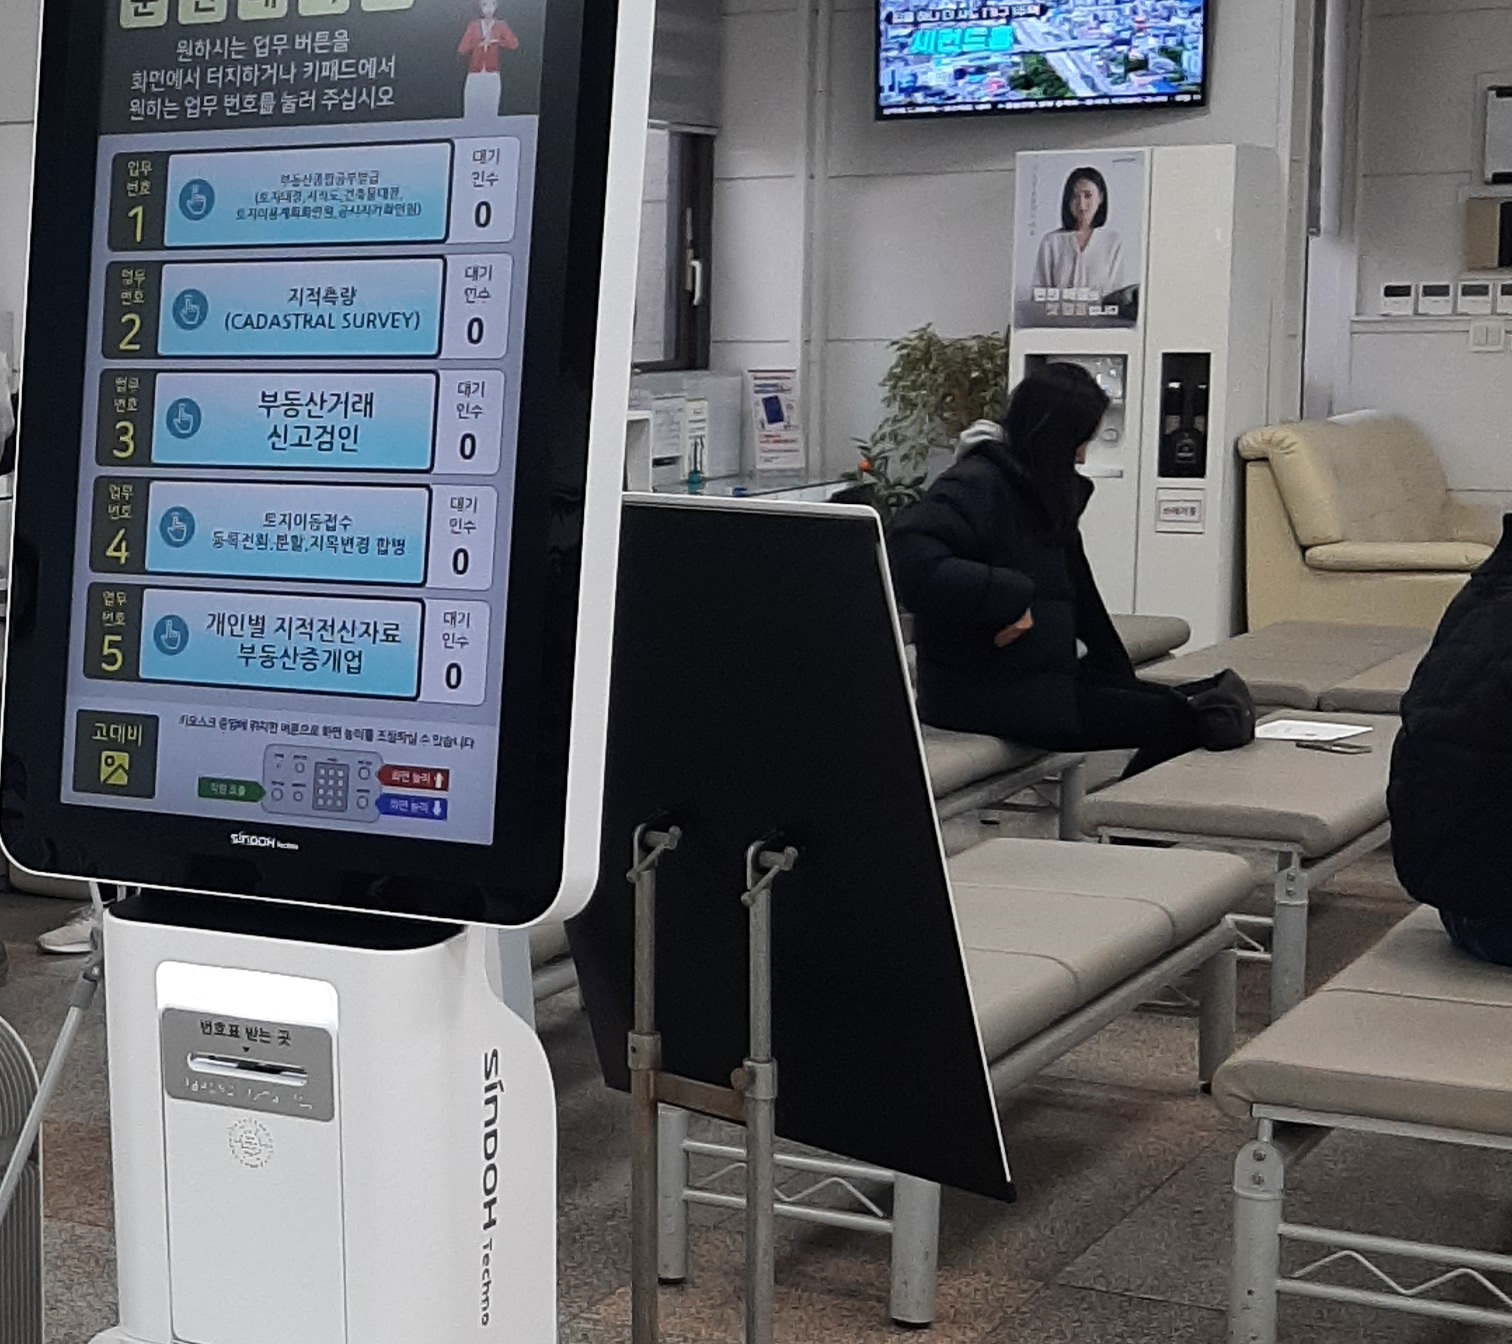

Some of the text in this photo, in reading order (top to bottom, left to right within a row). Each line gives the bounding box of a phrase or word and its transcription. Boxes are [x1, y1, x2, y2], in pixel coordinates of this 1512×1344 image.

[176, 29, 350, 61] 원하시는 업무 버튼을
[131, 65, 201, 92] 화면에서
[303, 56, 396, 82] 키패드에서
[130, 94, 180, 121] 원하는
[185, 93, 219, 118] 업무
[223, 90, 276, 116] 번호를
[322, 86, 396, 110] 주십시오
[127, 206, 143, 243] 1
[474, 200, 493, 229] 0
[119, 313, 141, 351] 2
[224, 311, 420, 332] (CADASTRAL SURVEY)
[467, 317, 484, 345] 0
[258, 391, 374, 419] 부동산거래
[112, 420, 136, 459] 3
[267, 424, 360, 453] 신고검인
[459, 433, 477, 460] 0
[262, 512, 353, 531] 토지이동접수
[105, 527, 129, 566] 4
[452, 547, 469, 575] 0
[206, 612, 266, 640] 개인별
[100, 634, 123, 672] 5
[445, 663, 462, 690] 0
[92, 722, 143, 748] 고대비
[200, 1020, 291, 1046] 번호표 받는 곳
[481, 1238, 492, 1326] Techno
